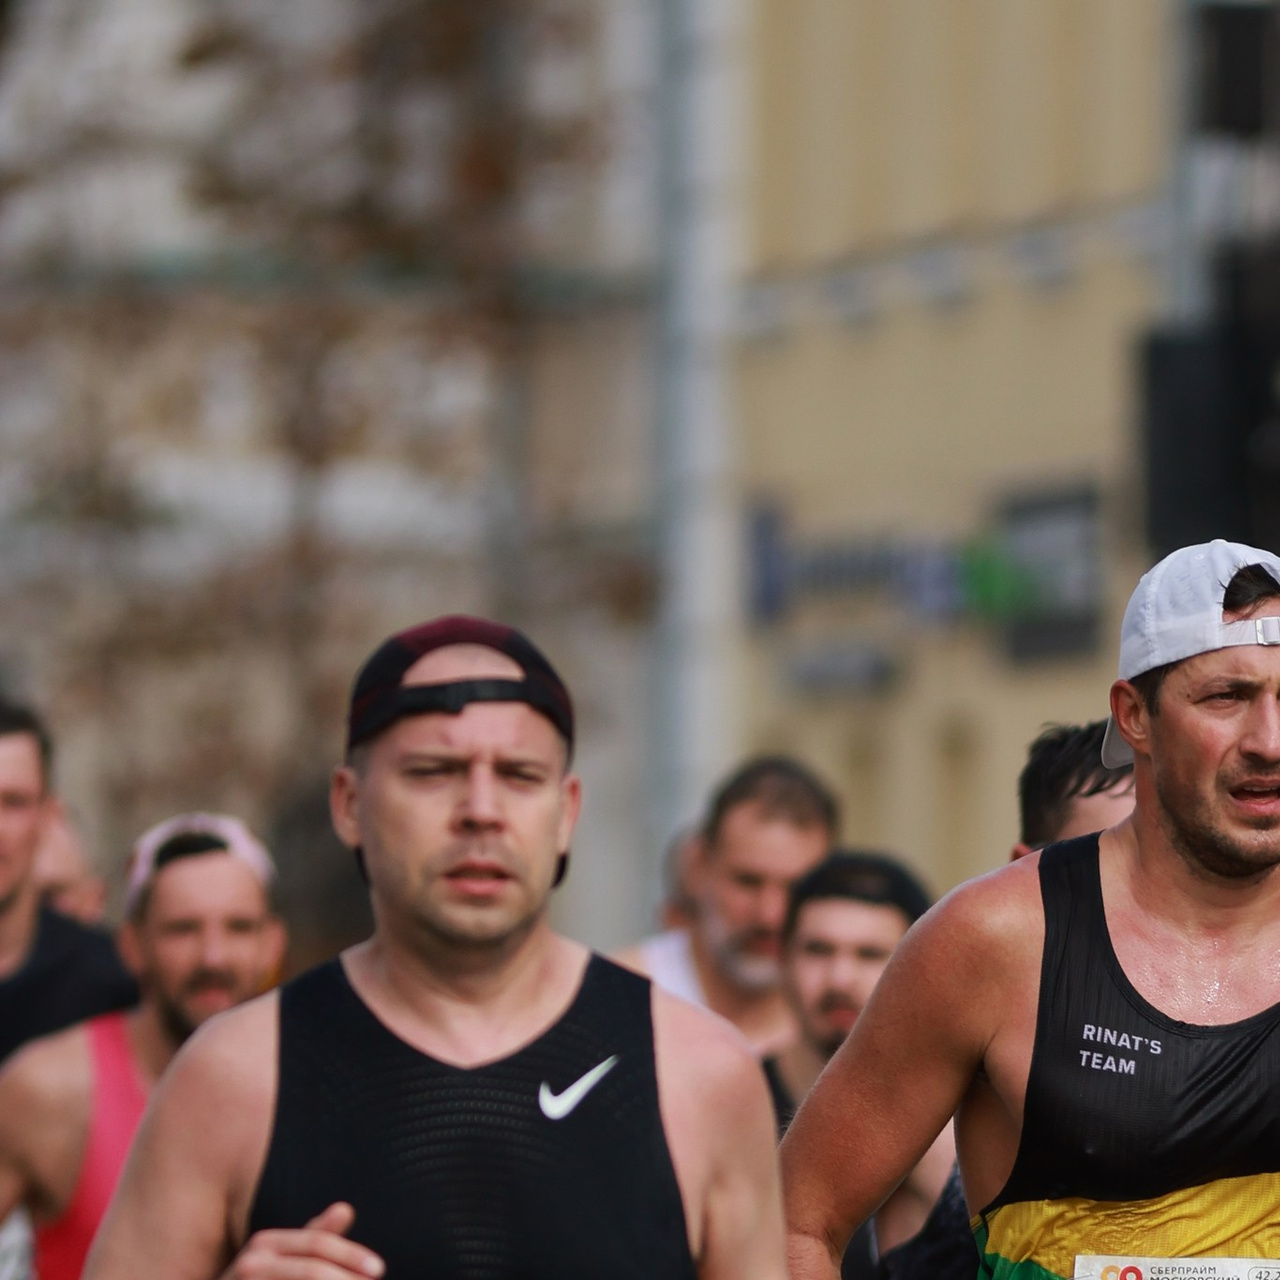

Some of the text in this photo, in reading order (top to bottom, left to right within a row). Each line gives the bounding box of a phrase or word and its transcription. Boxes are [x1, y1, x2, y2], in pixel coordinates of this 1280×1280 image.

[1082, 1024, 1162, 1055] RINAT'S
[1079, 1049, 1136, 1075] TEAM
[1150, 1265, 1217, 1275] СБЕРПРАЙМ
